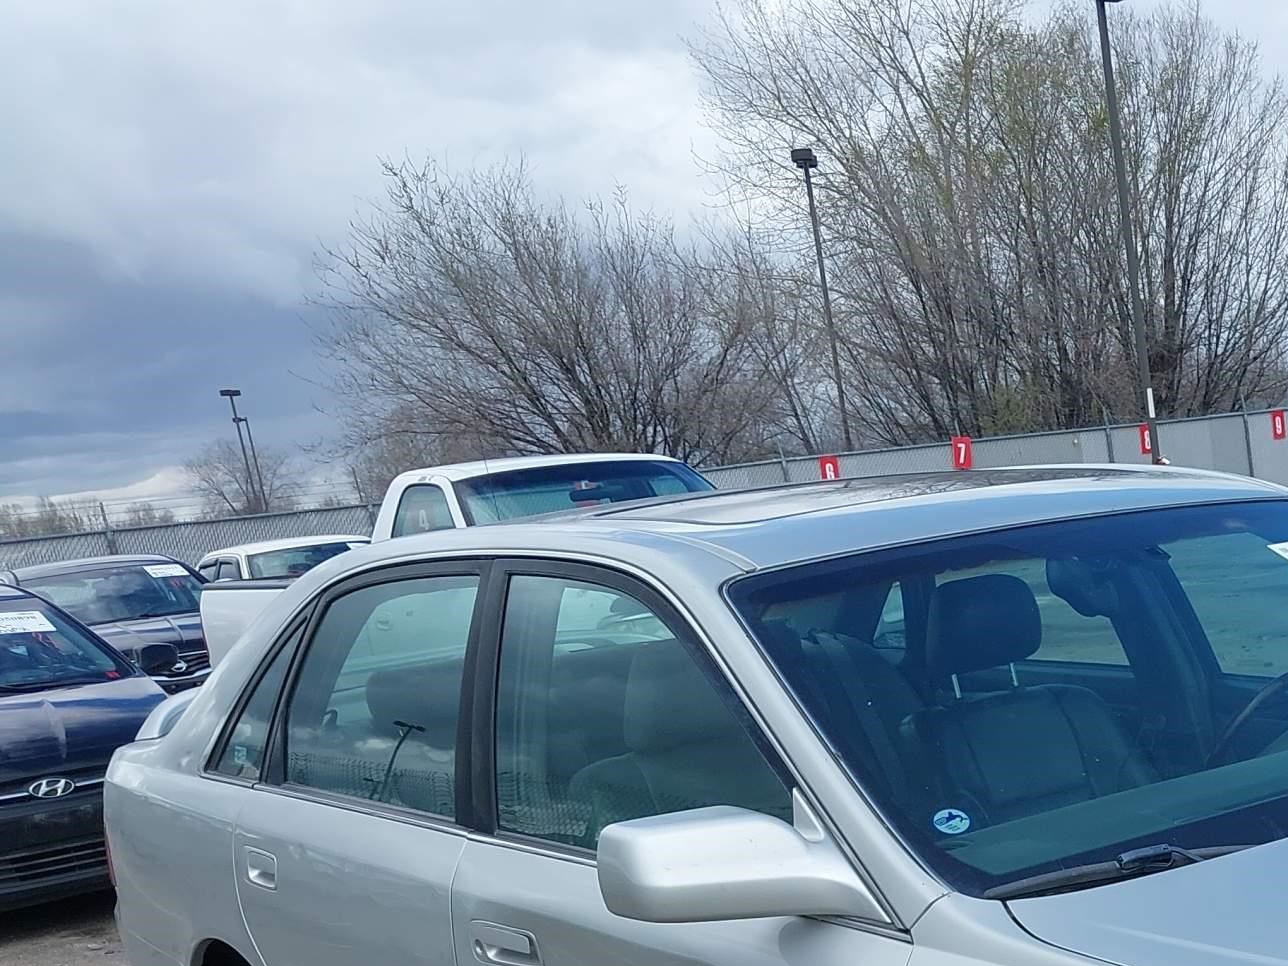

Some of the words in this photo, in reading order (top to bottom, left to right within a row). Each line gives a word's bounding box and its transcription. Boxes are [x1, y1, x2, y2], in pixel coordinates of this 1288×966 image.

[1275, 415, 1283, 435] 9
[1144, 430, 1152, 449] 8
[957, 443, 966, 464] 7
[825, 462, 835, 480] 6
